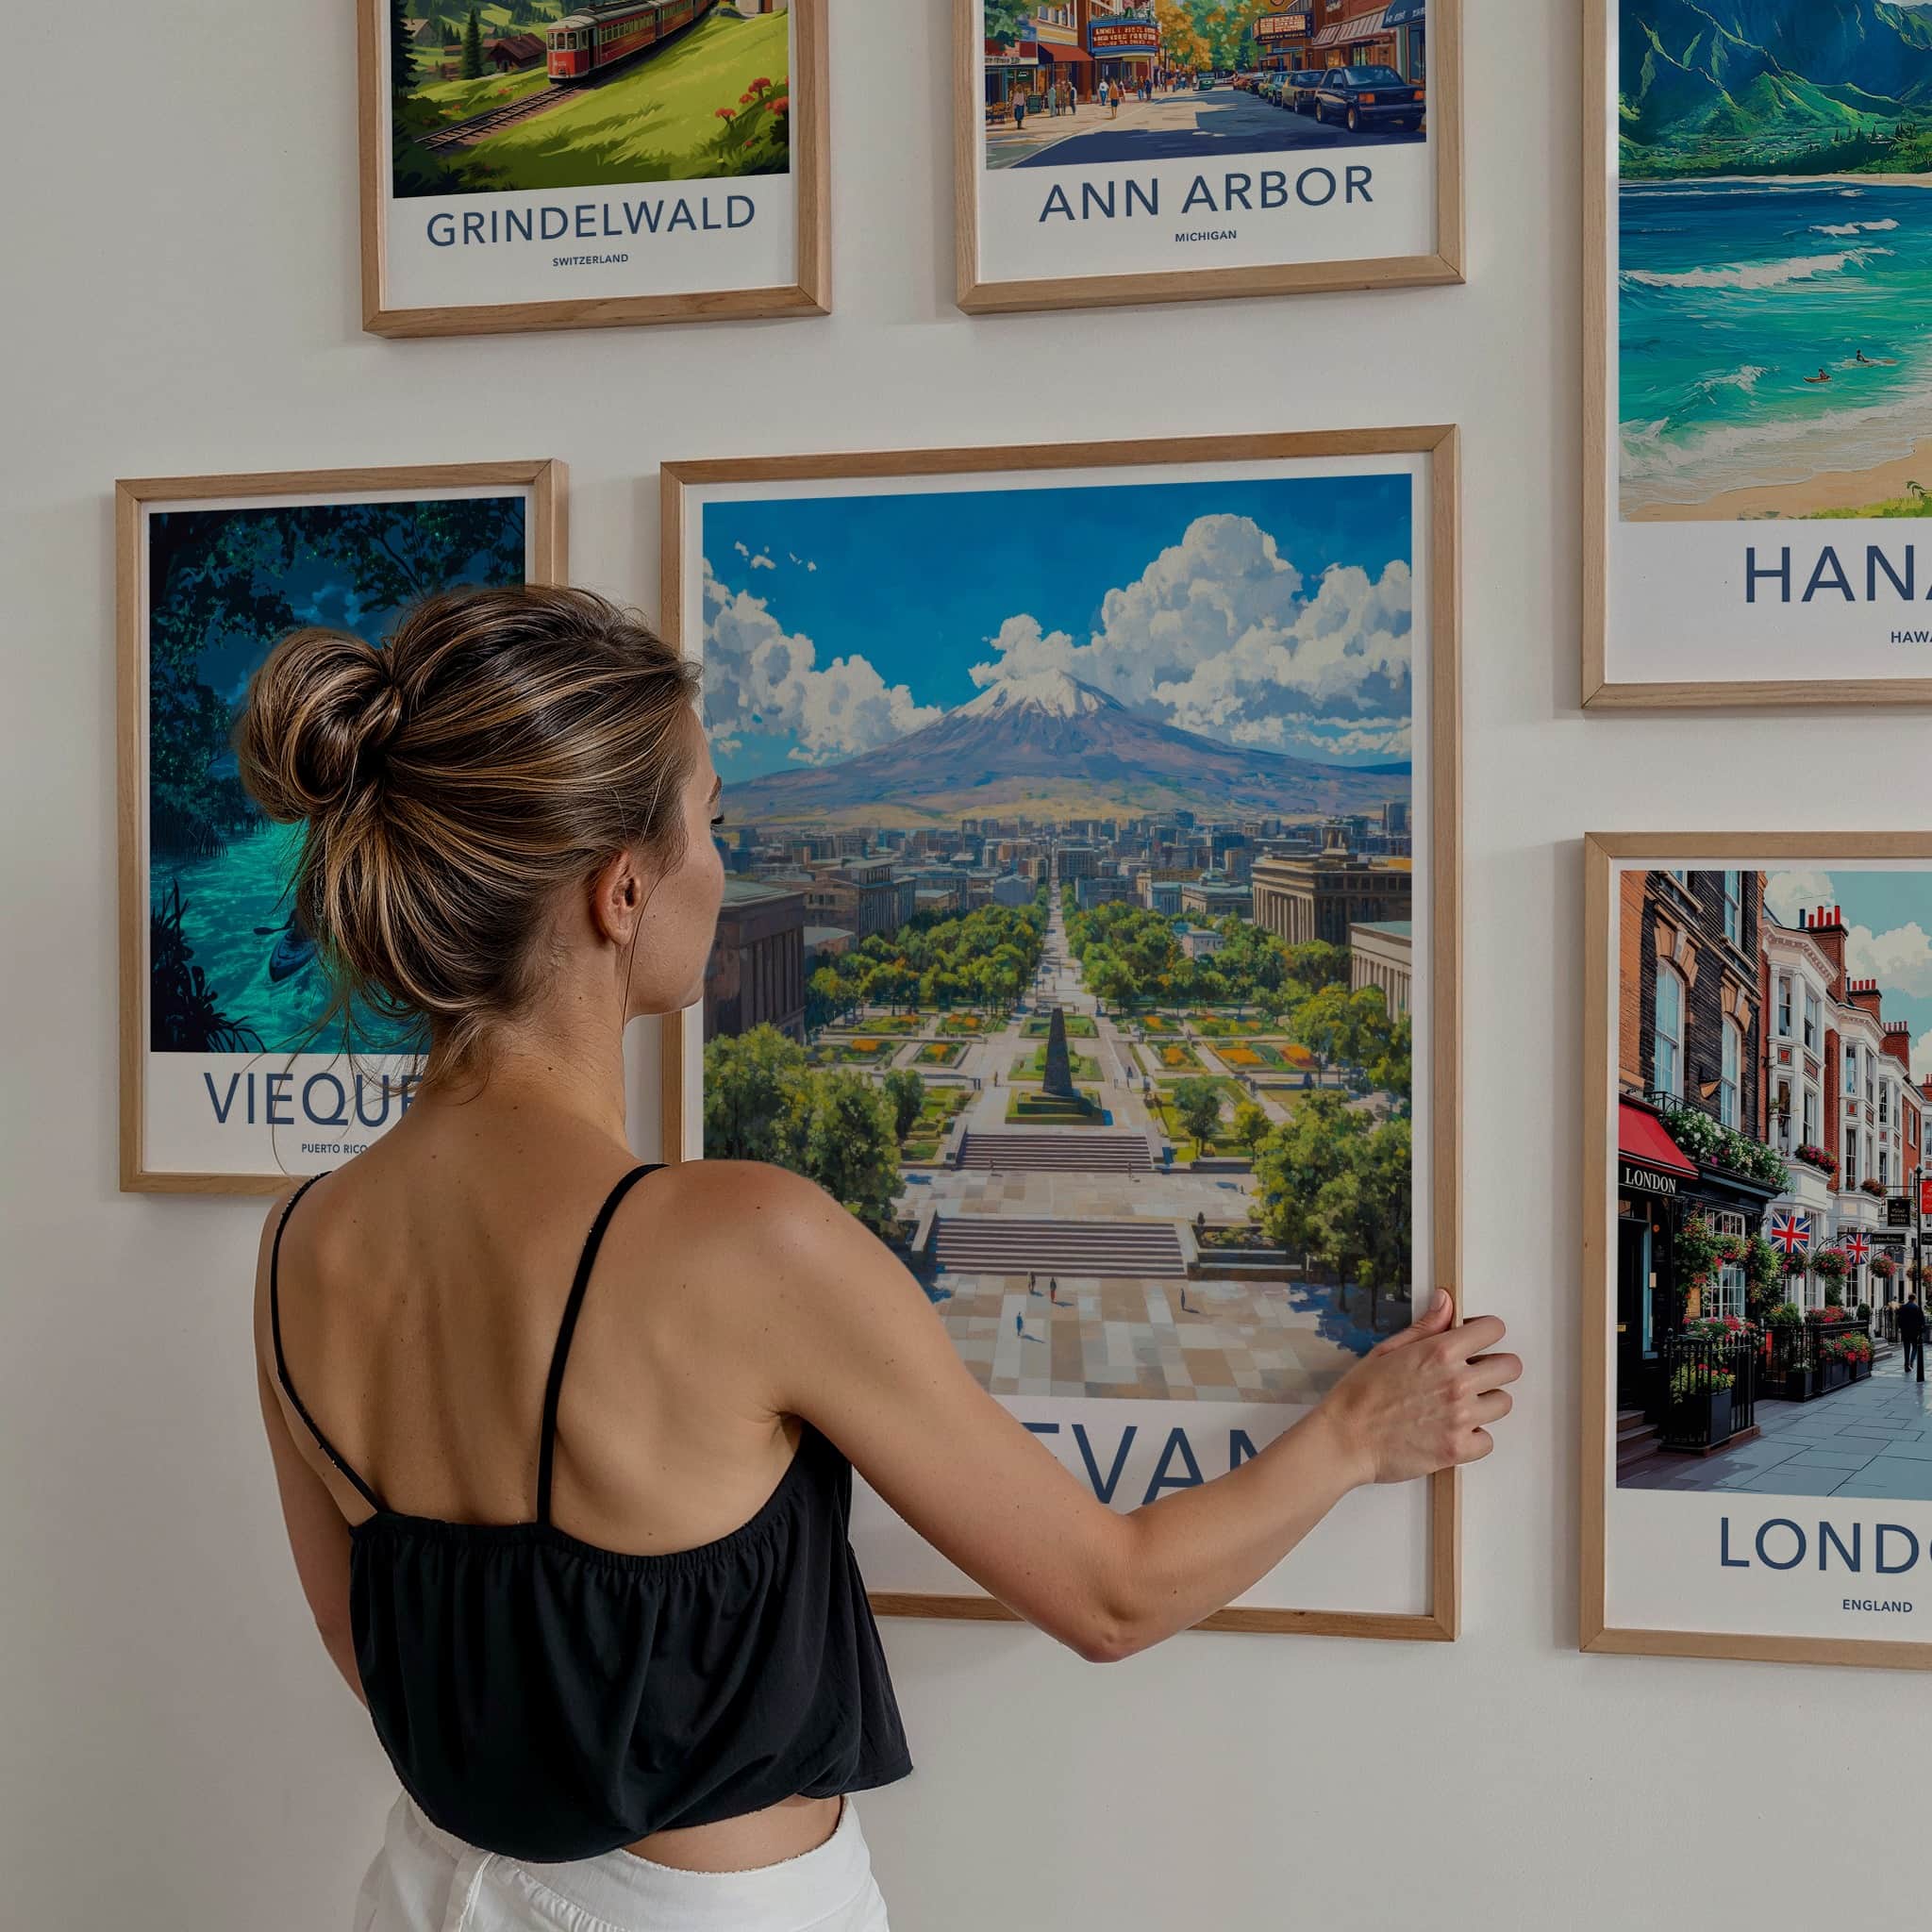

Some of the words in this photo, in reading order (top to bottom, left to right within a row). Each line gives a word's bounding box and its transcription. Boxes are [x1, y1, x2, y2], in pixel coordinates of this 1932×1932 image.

[1039, 177, 1159, 223] ANN
[1181, 165, 1374, 214] ARBOR
[426, 194, 756, 247] GRINDELWALD
[1174, 230, 1238, 242] MICHIGAN
[552, 254, 629, 267] SWITZERLAND
[1745, 544, 1932, 603] HAN
[1890, 630, 1932, 643] HAW
[301, 1143, 341, 1154] PUERTO
[1624, 1167, 1676, 1194] LONDON
[1721, 1517, 1932, 1574] LOND
[1842, 1599, 1913, 1613] ENGLAND
